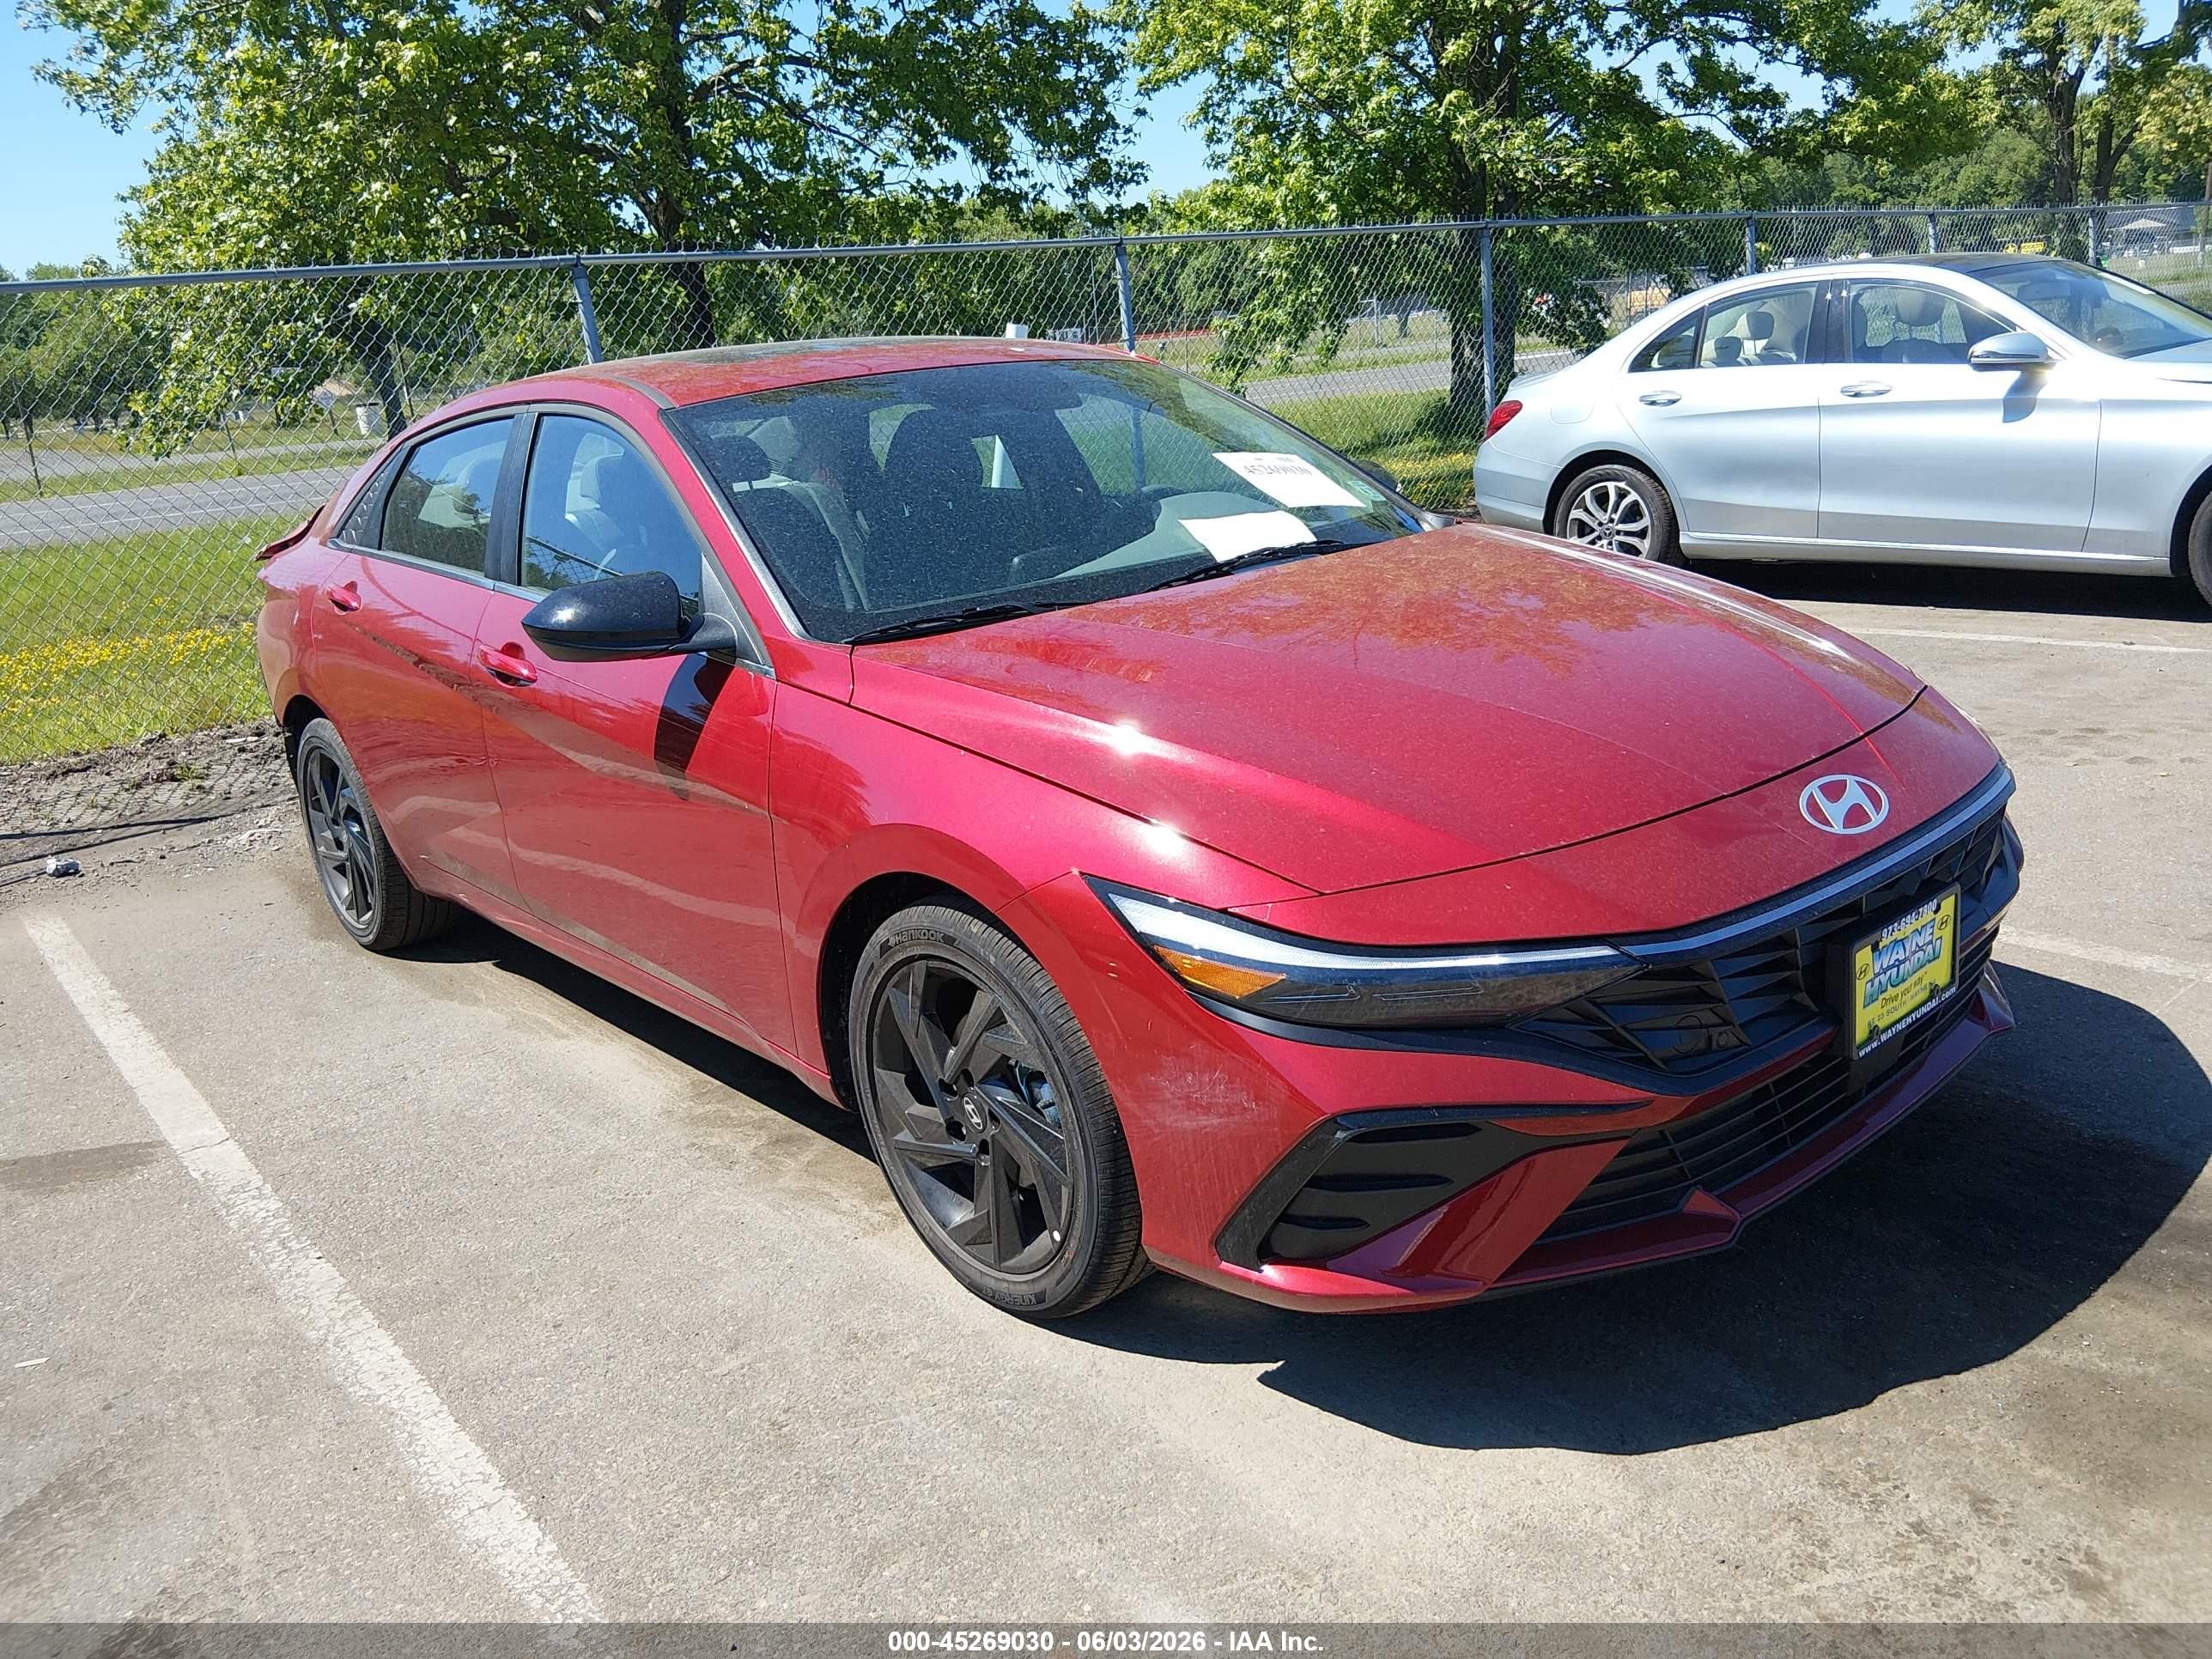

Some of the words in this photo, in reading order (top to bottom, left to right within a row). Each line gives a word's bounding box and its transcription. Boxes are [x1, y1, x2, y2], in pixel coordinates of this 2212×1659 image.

[1881, 898, 1937, 939] 973-694-7800
[1863, 935, 1943, 1009] HYUNDAI
[1872, 919, 1936, 975] WAYNE
[1858, 986, 1956, 1058] www.WAYNEHYUNDAI.com
[1881, 992, 1899, 1009] Drive
